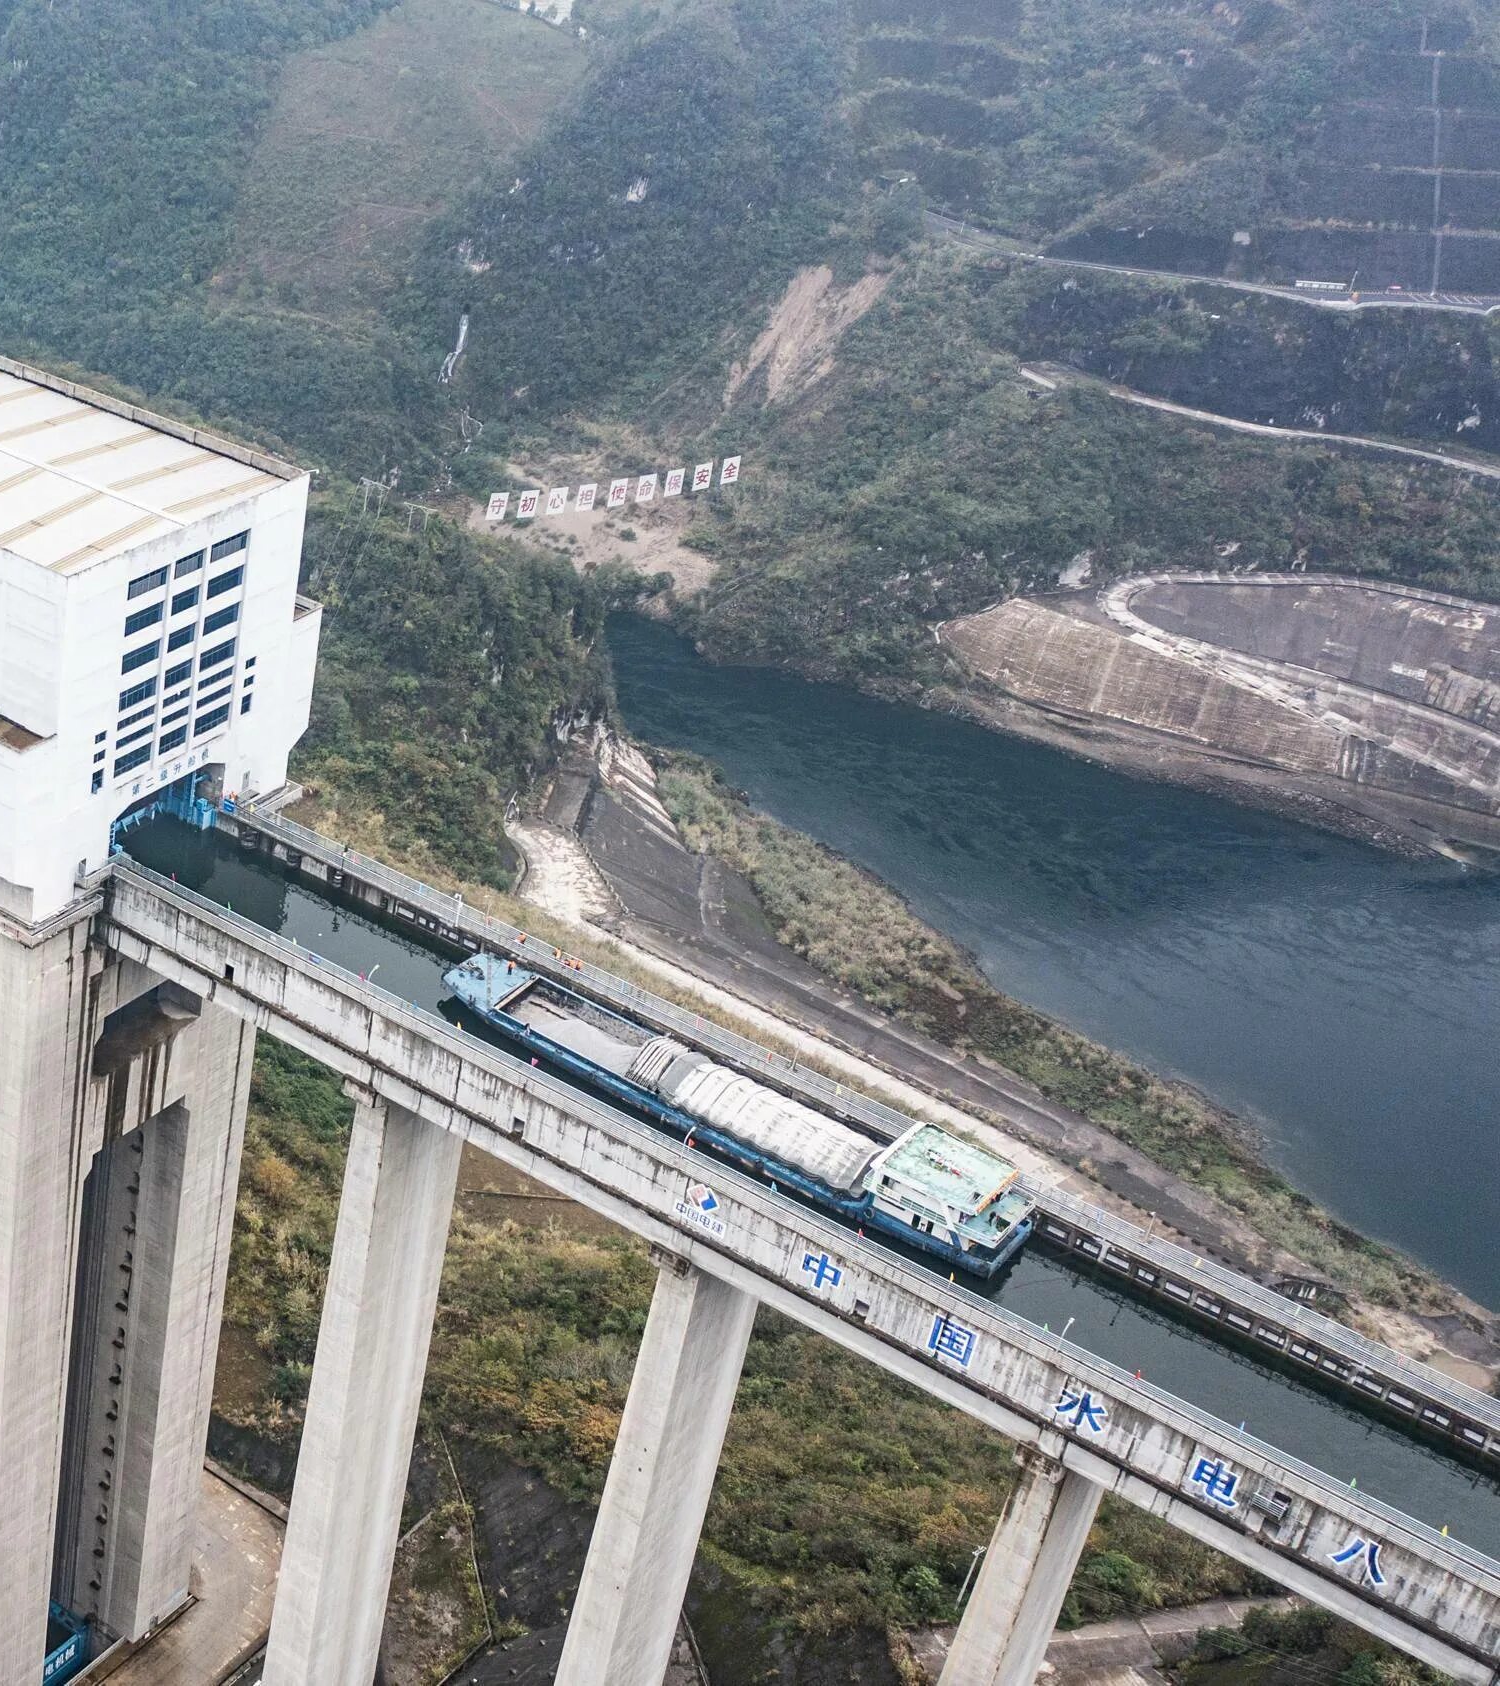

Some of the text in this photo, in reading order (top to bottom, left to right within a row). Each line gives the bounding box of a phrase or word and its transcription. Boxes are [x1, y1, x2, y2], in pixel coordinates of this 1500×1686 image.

[490, 462, 737, 515] 守初心担使命保安全
[676, 1203, 723, 1233] 中国电建
